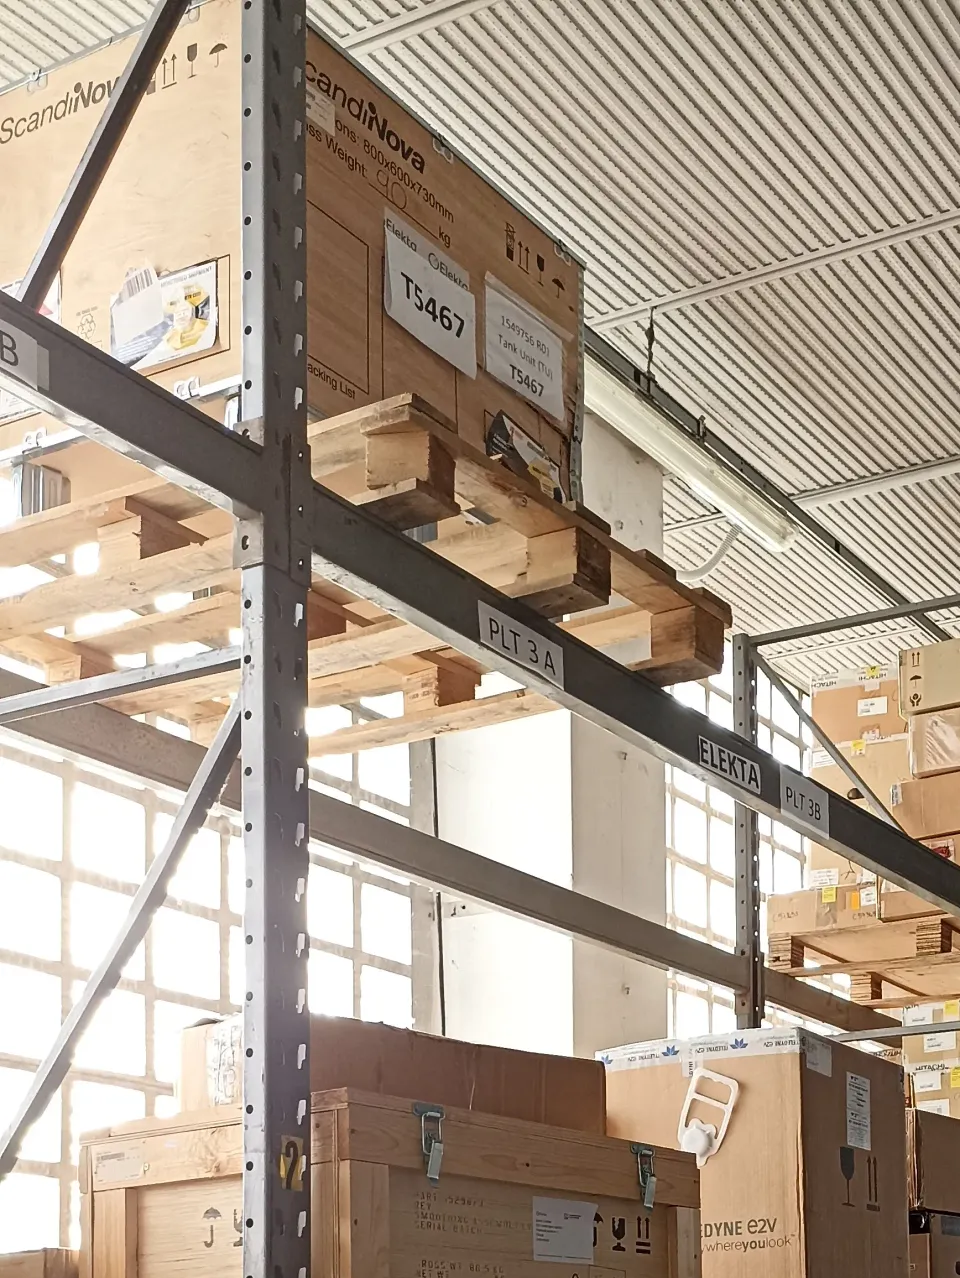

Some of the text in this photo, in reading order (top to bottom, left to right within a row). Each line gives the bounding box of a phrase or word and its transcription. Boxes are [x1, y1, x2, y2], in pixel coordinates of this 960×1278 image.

[0, 76, 121, 143] ScandiNov
[306, 61, 425, 174] candiNova
[325, 135, 367, 178] Weight:
[386, 218, 417, 252] Elekta
[438, 226, 451, 248] kg
[401, 272, 465, 338] T5467
[498, 334, 517, 355] Tank
[519, 349, 536, 368] Unit
[307, 363, 356, 400] acking List
[510, 364, 544, 397] T5467
[488, 617, 521, 656] PLT
[699, 737, 760, 790] ELEKTA
[785, 785, 806, 812] PLT
[747, 1218, 777, 1234] e2v
